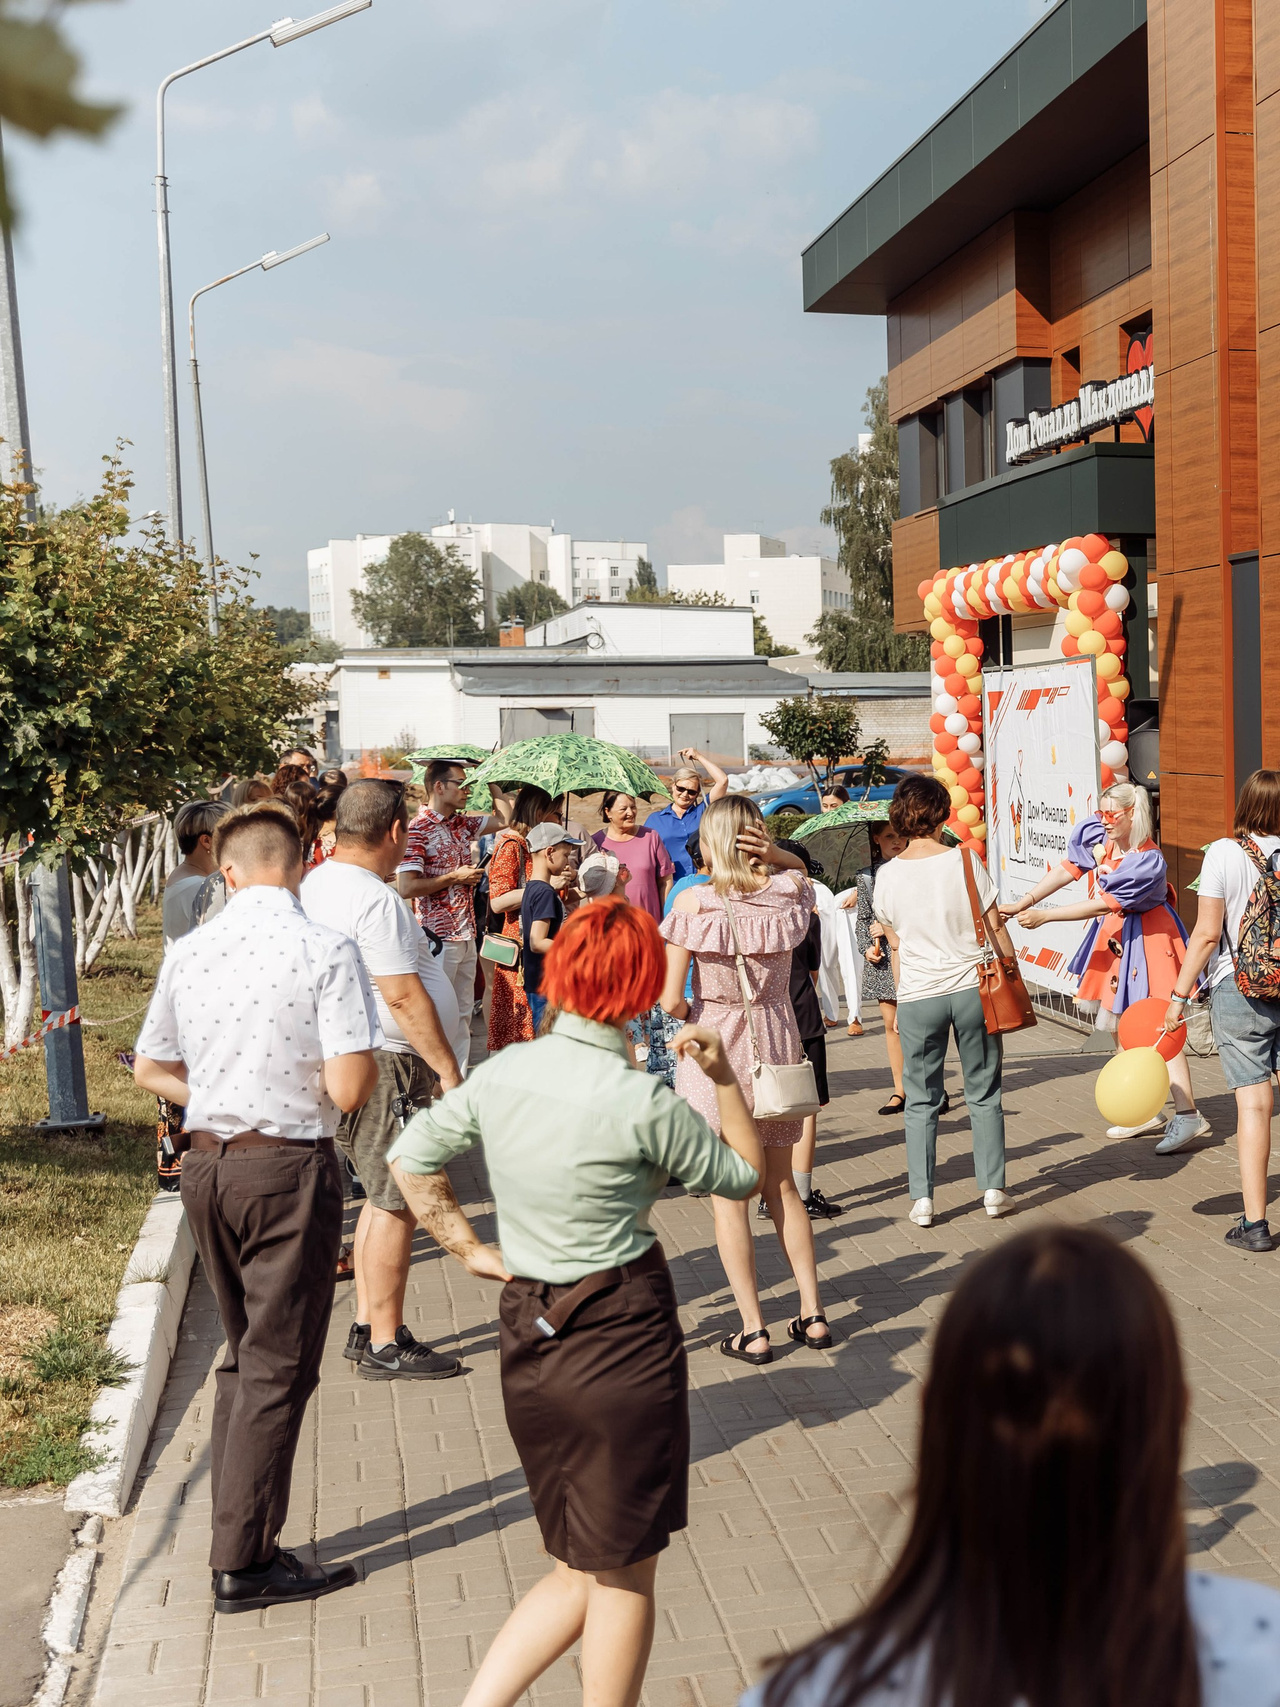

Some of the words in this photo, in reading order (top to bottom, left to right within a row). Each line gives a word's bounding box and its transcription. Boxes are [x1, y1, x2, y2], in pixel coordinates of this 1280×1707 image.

[1006, 421, 1030, 463] Дом
[1029, 400, 1081, 449] Роналда
[1027, 800, 1040, 824] Дом
[1041, 801, 1068, 827] Роналда
[1028, 827, 1067, 854] Макдоналда
[1028, 853, 1044, 868] Россия
